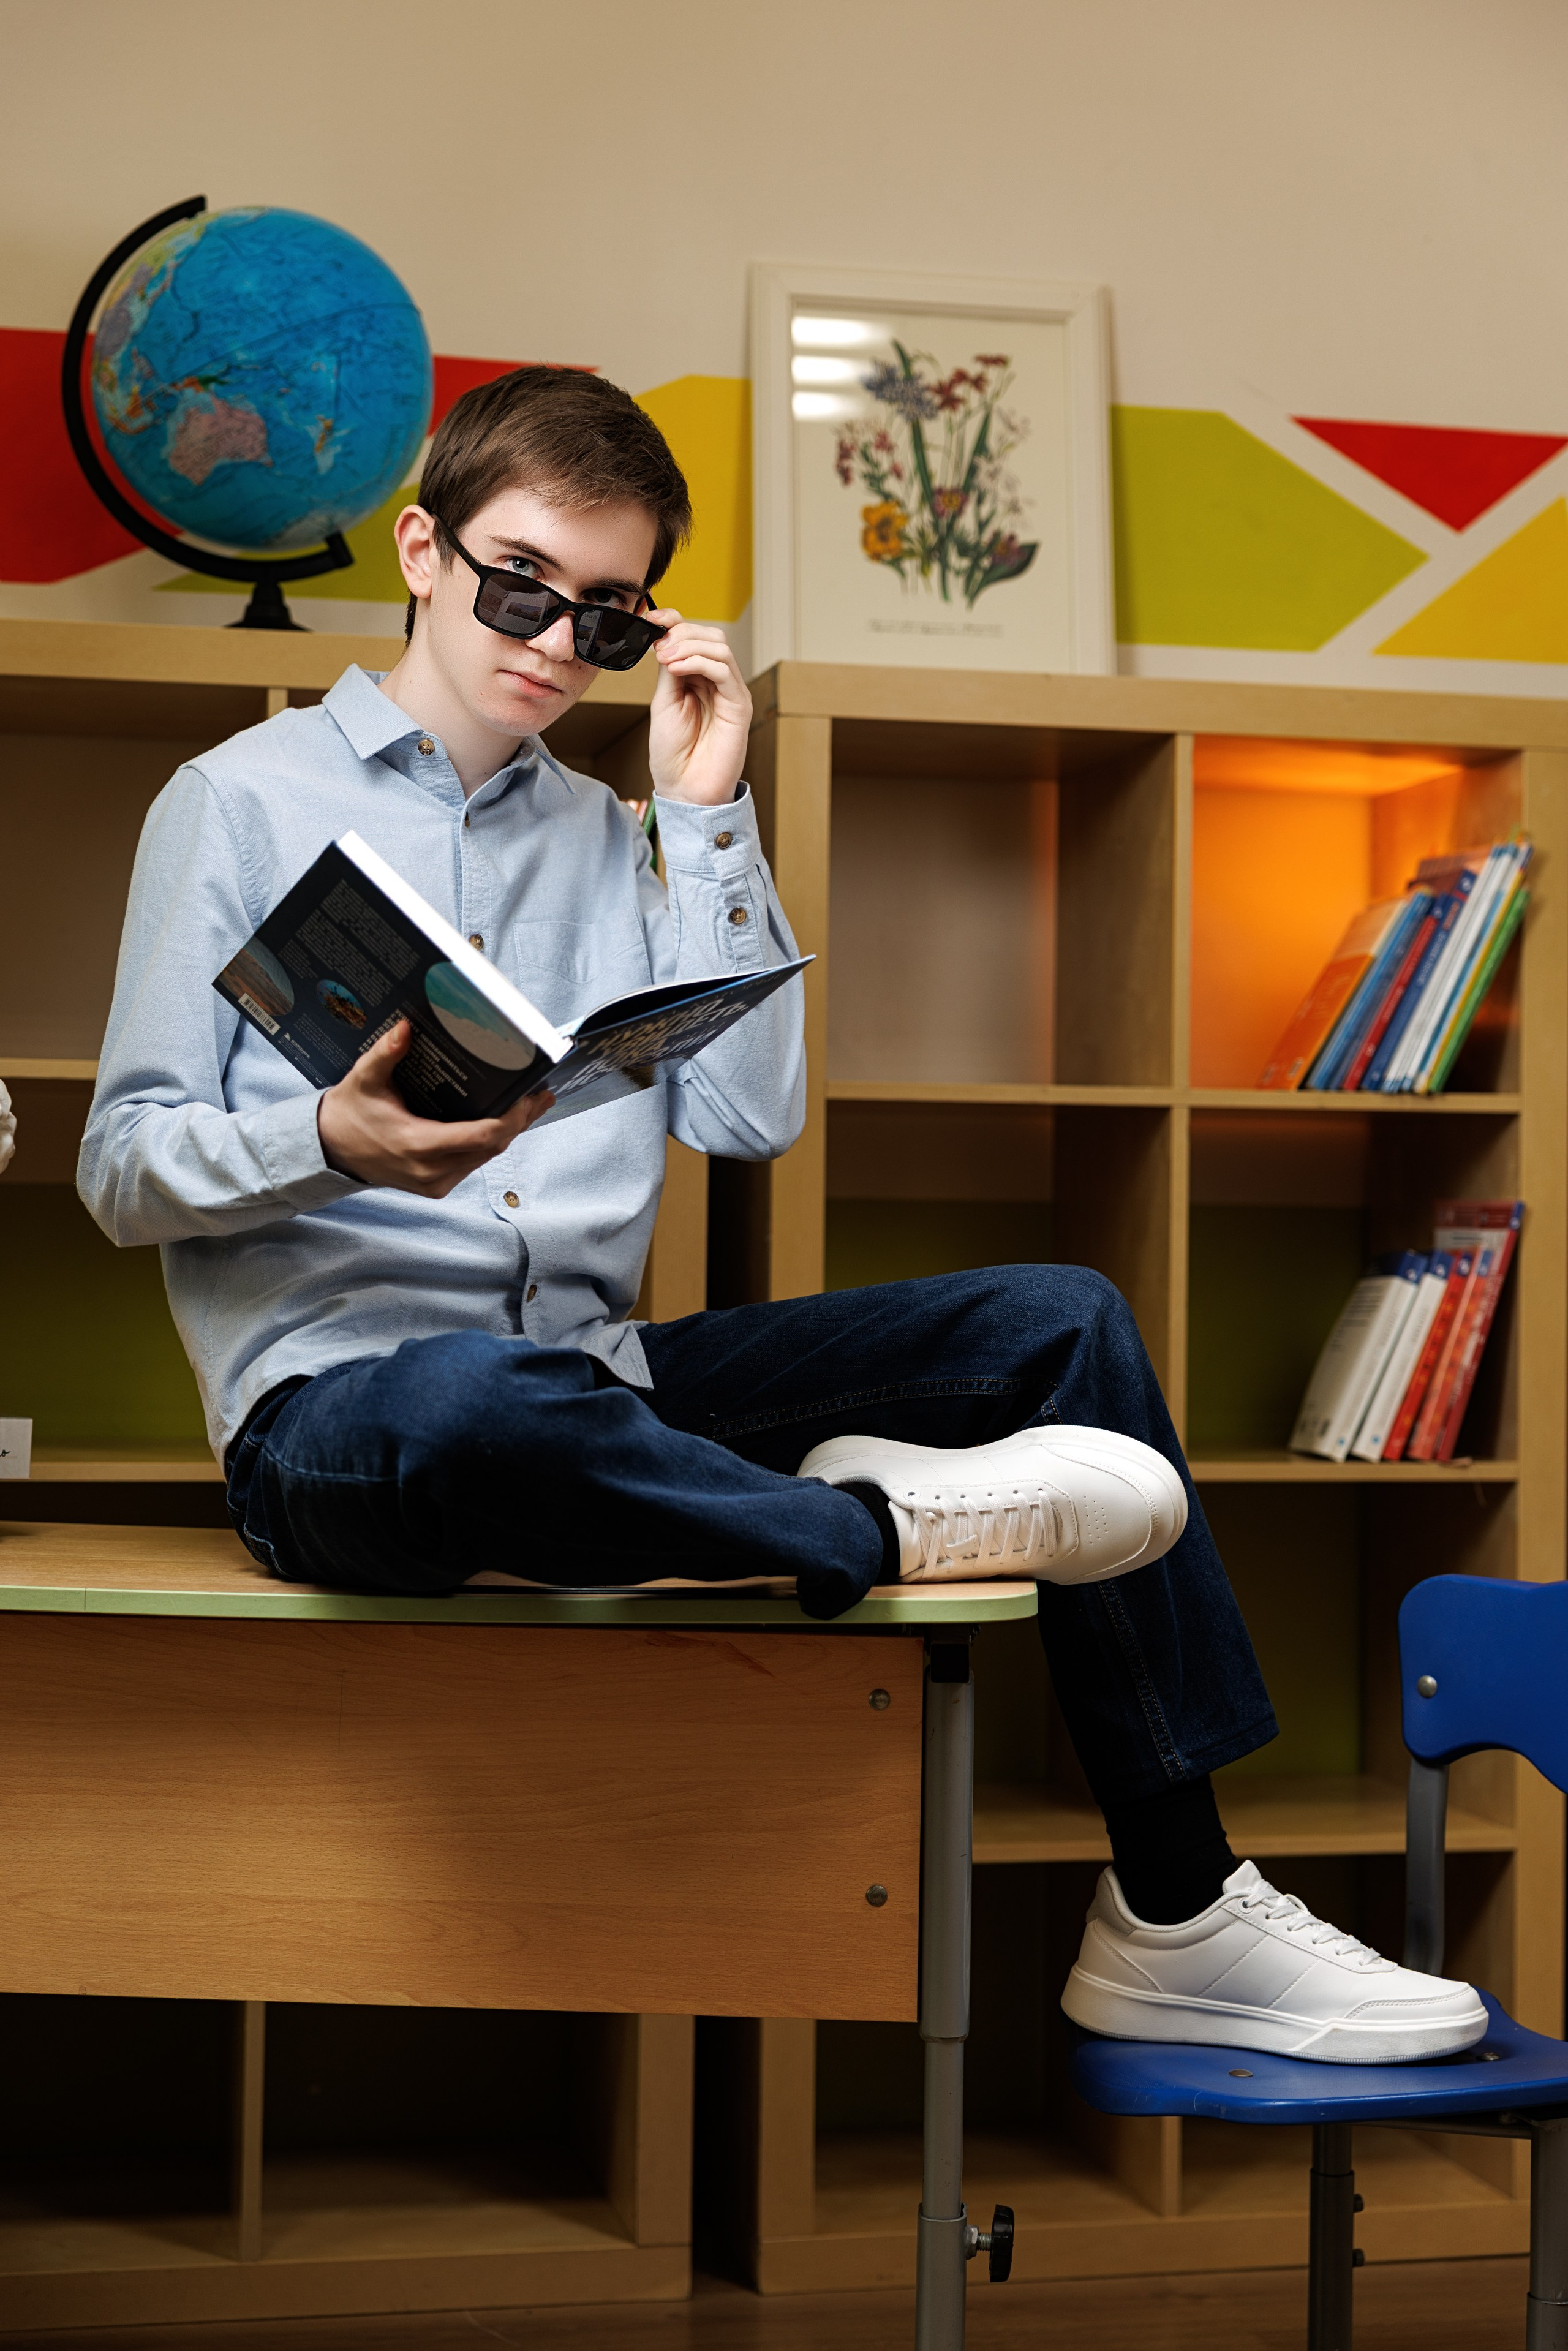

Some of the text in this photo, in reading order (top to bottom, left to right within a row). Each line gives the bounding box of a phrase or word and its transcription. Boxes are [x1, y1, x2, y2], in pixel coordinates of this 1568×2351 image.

[292, 1039, 310, 1059] БОМБОРА
[585, 997, 725, 1056] НУЖНО
[419, 1032, 469, 1081] ПОЗНАКОМИТЬСЯ
[571, 1036, 669, 1079] ПОКА
